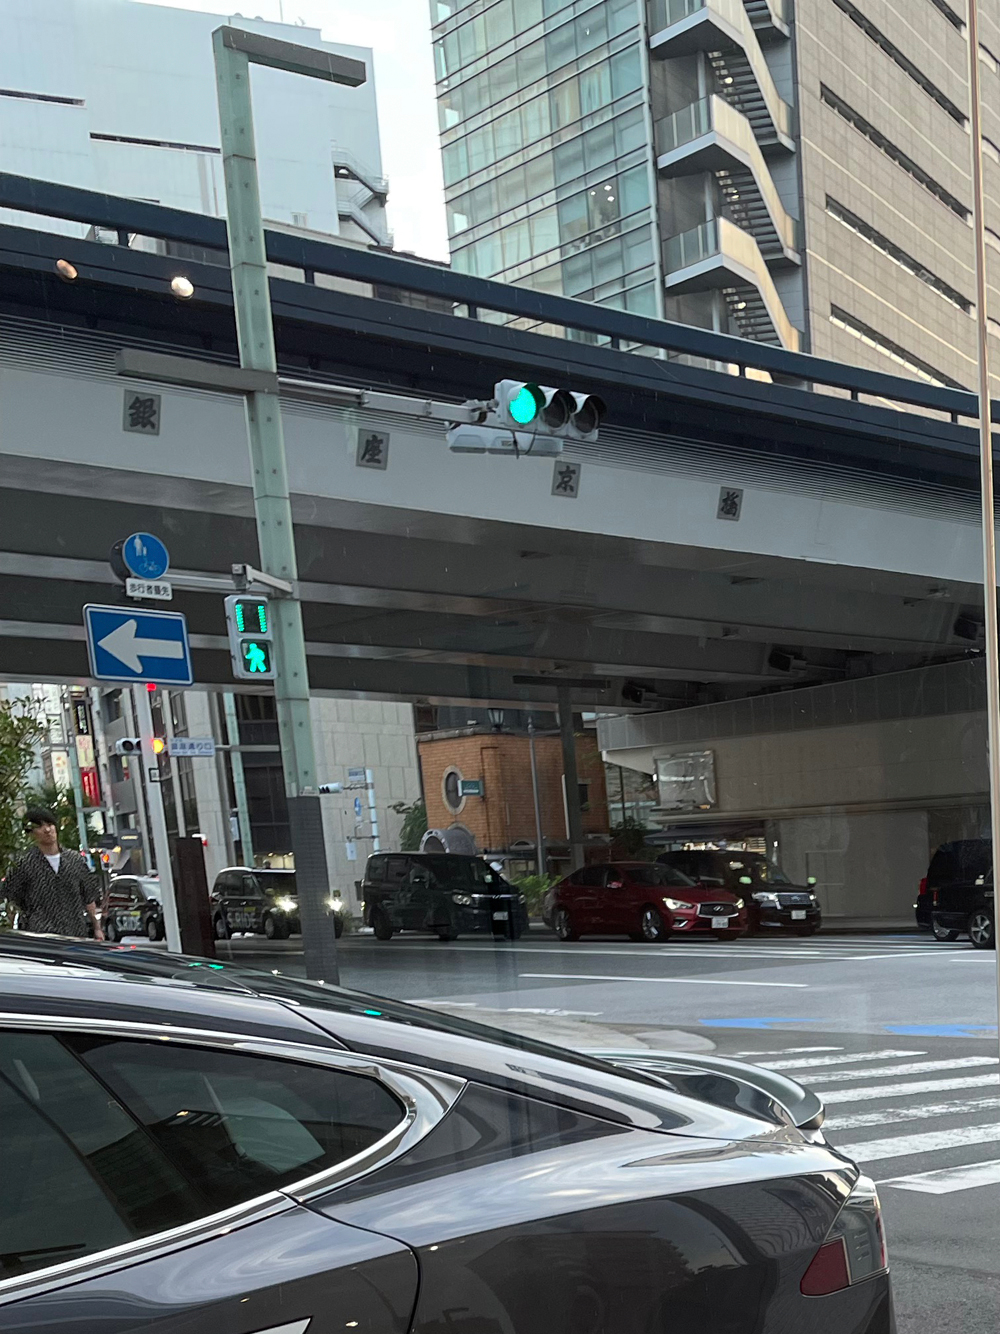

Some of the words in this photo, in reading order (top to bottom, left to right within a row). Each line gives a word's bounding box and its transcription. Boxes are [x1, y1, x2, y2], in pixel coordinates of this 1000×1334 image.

[128, 396, 157, 430] 銀
[360, 434, 384, 464] 座
[556, 465, 577, 493] 京
